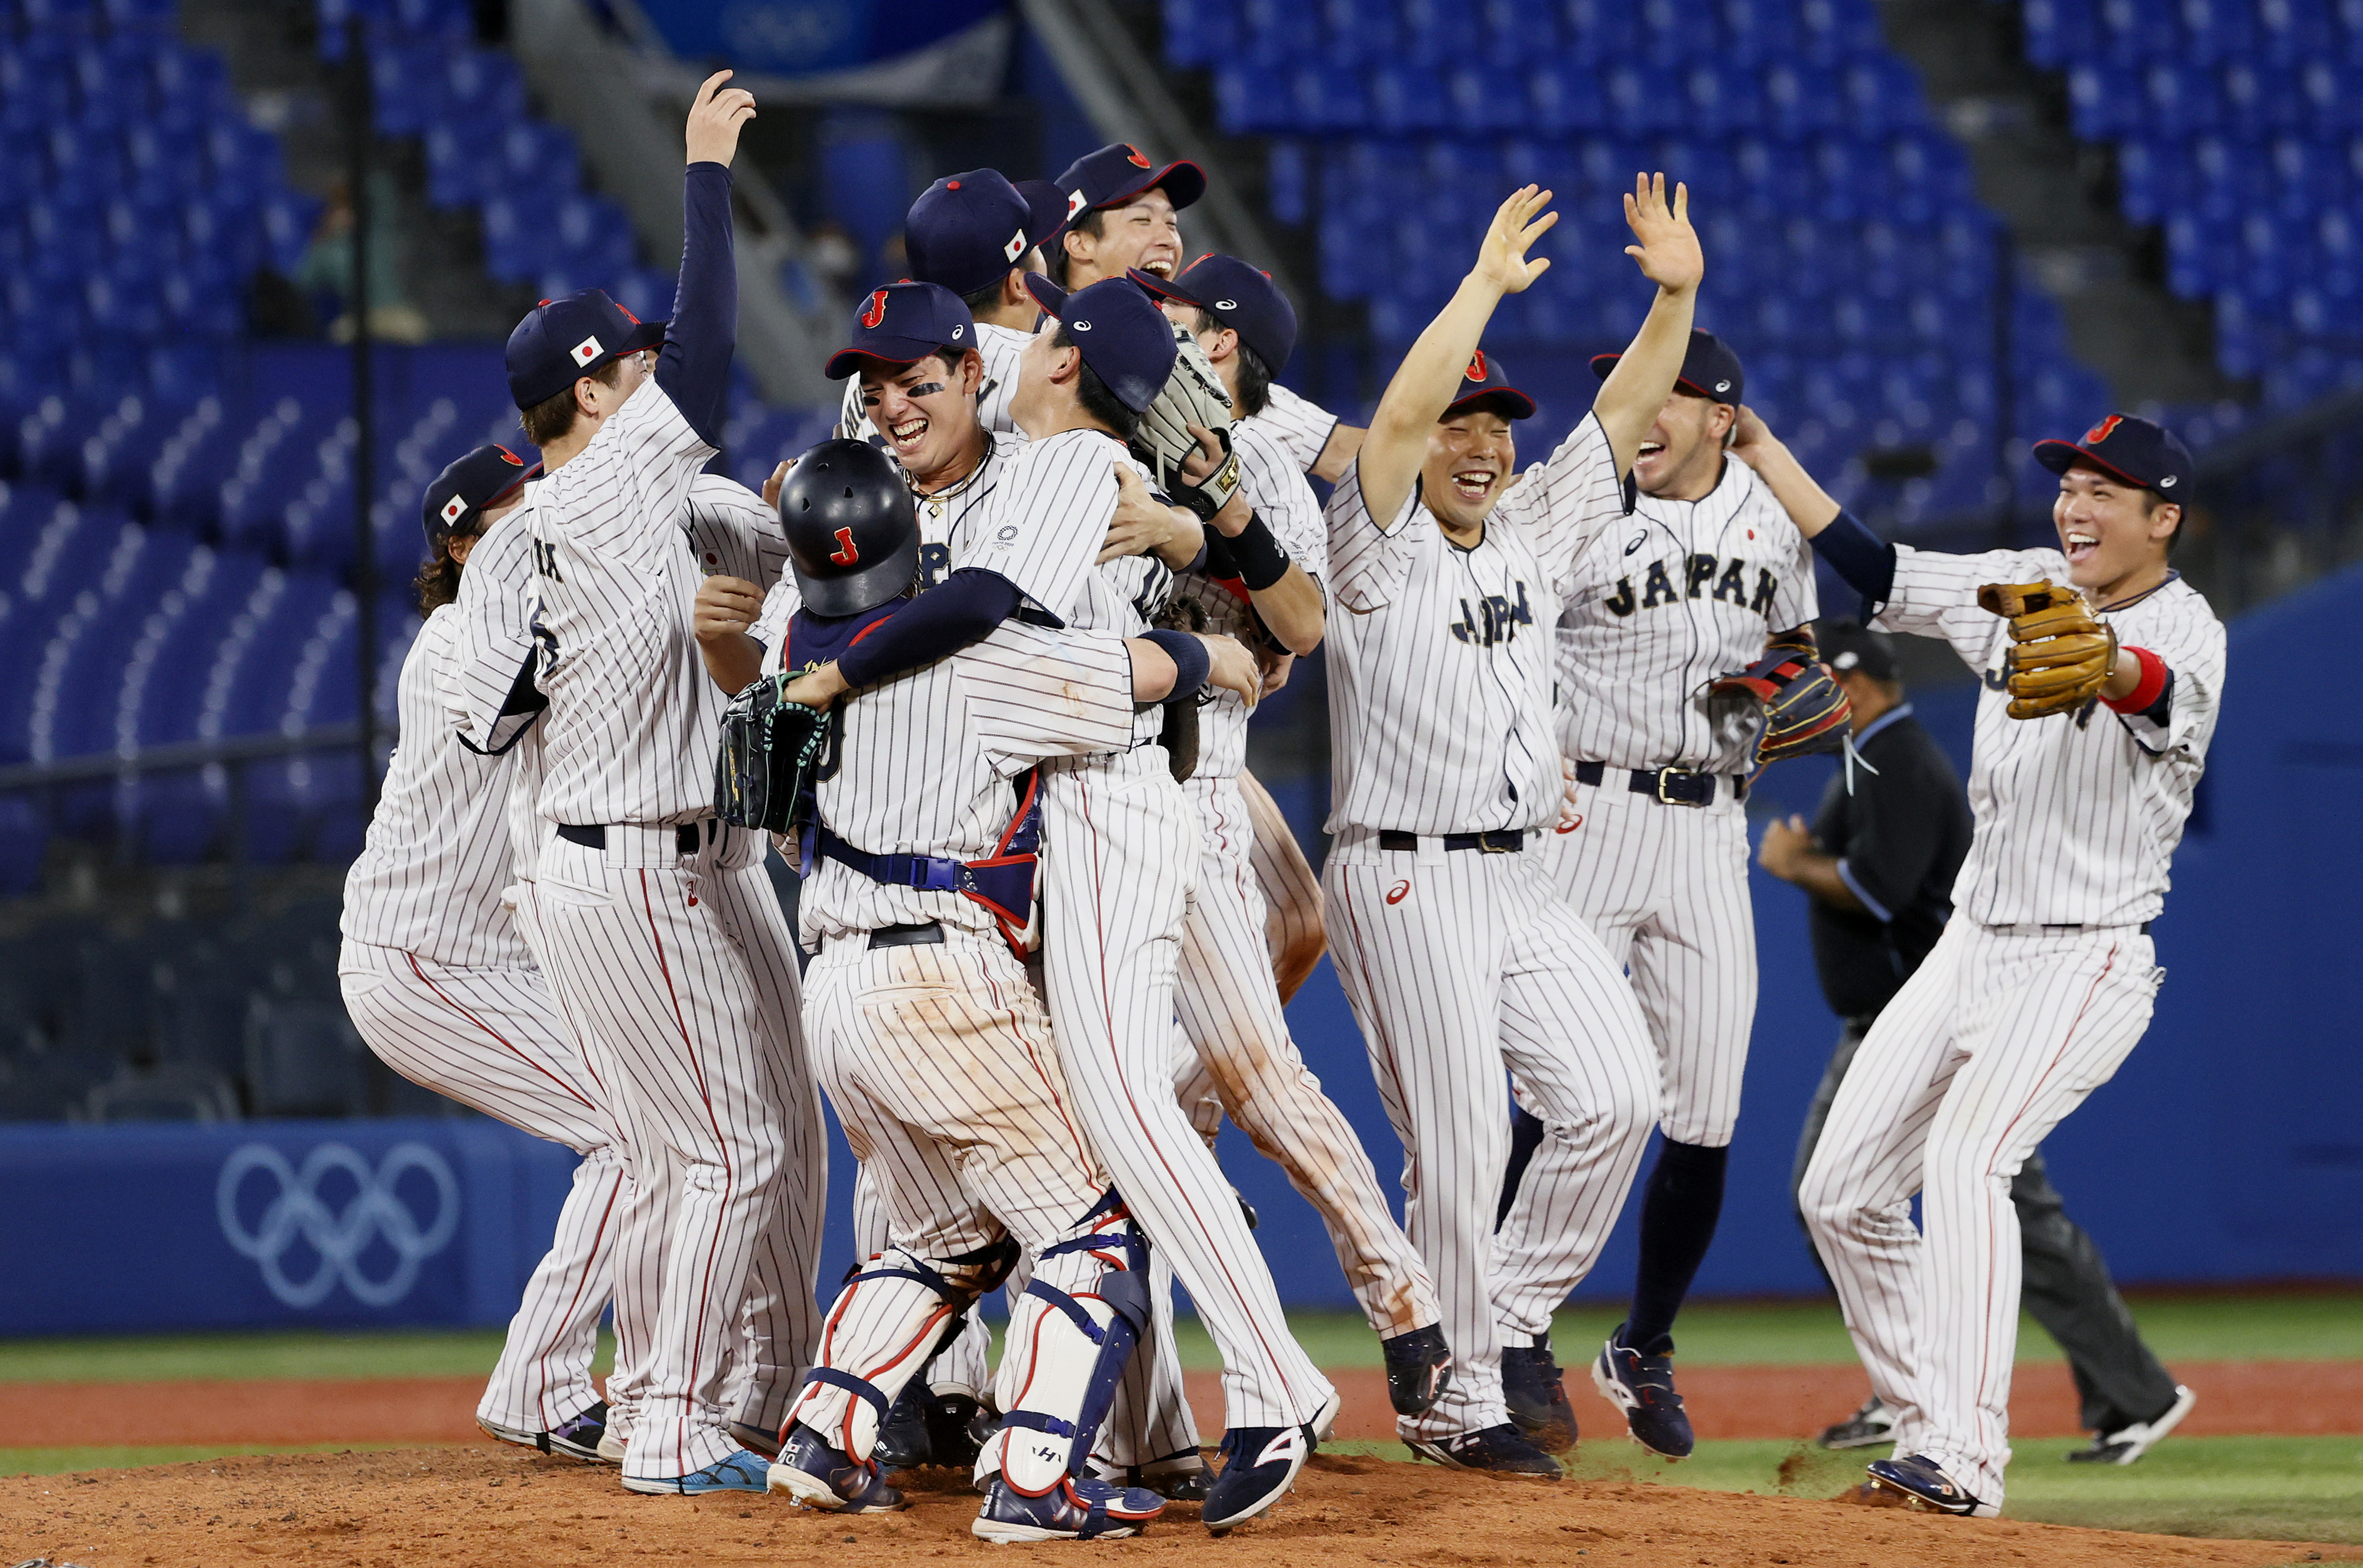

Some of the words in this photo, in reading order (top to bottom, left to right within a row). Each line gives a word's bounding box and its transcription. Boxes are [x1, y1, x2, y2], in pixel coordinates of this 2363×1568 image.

[862, 291, 888, 329] J
[1464, 350, 1487, 383] J
[2087, 415, 2124, 444] J
[830, 526, 858, 566] J
